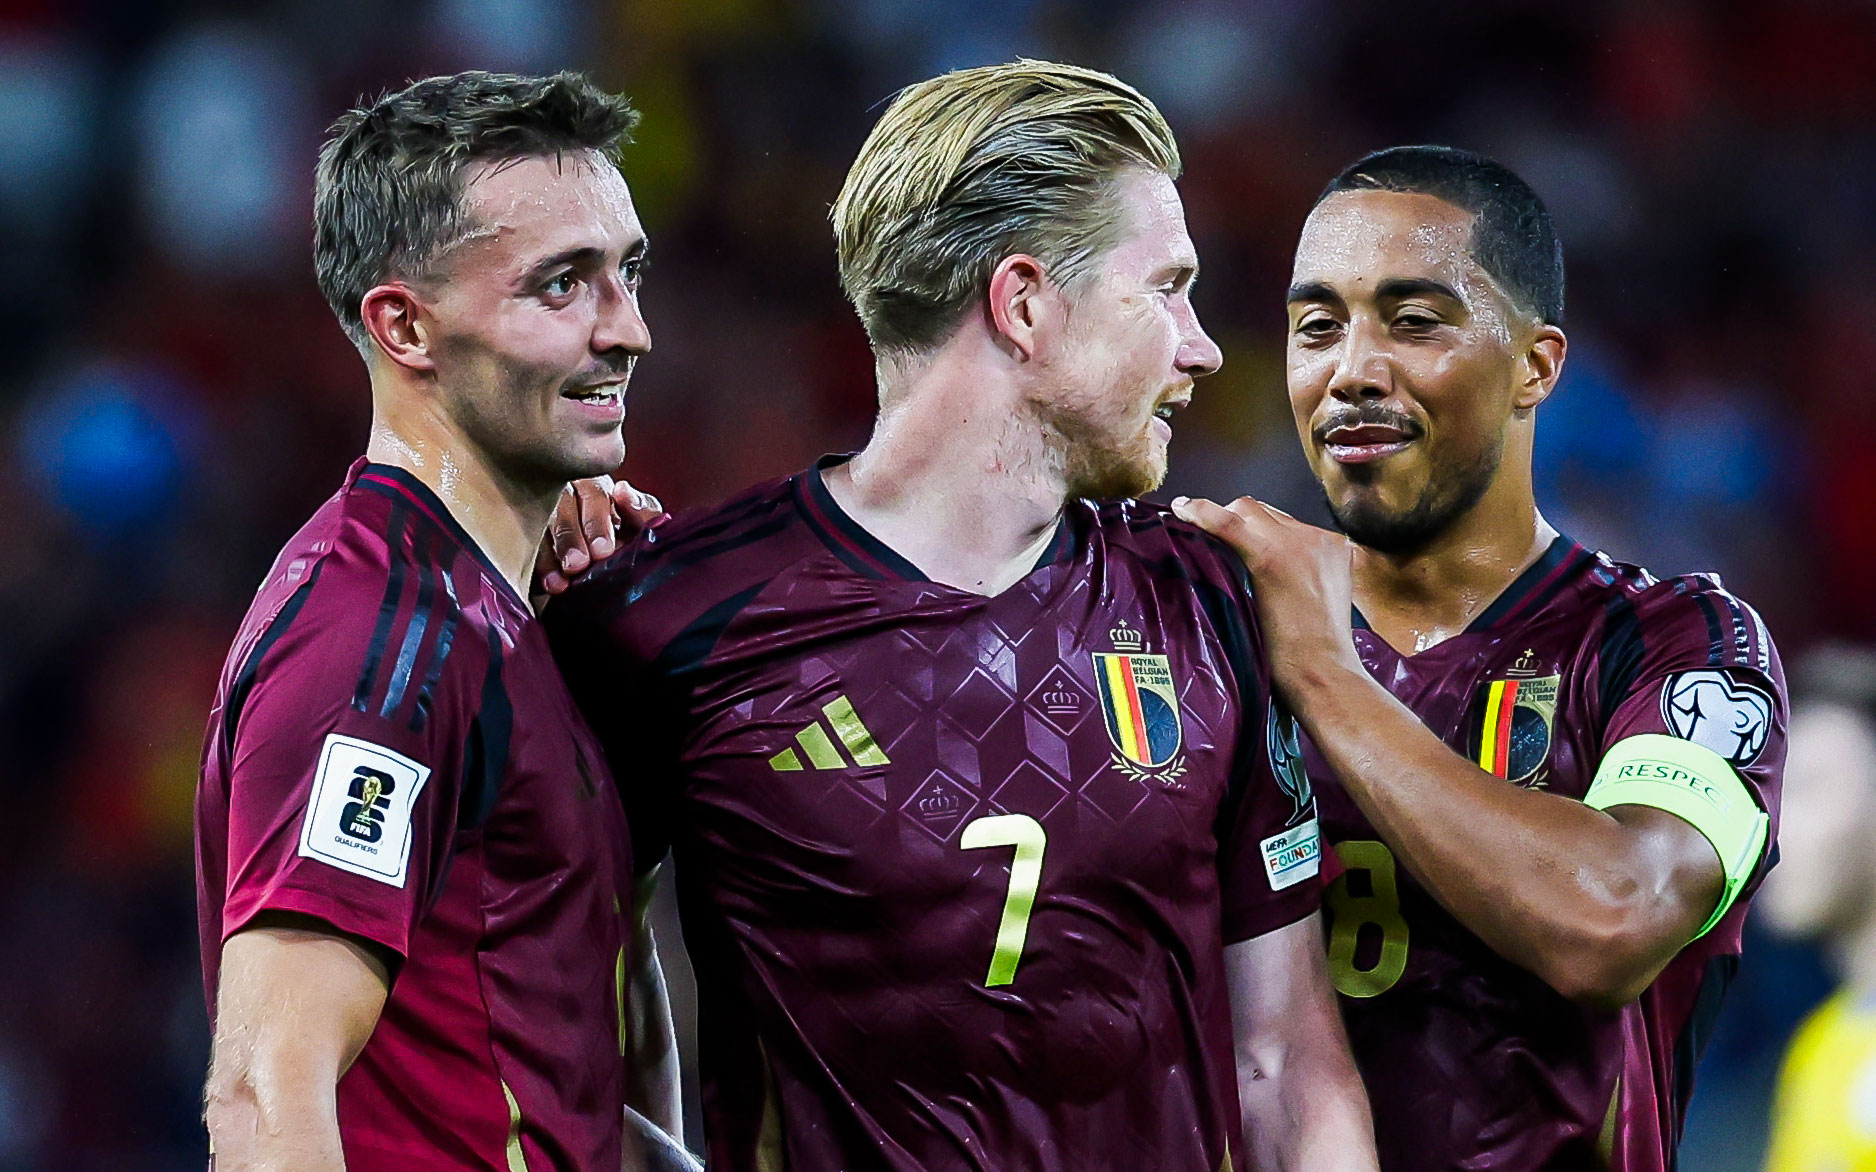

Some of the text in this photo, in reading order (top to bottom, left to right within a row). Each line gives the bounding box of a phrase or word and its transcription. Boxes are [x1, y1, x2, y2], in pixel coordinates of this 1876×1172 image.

[1618, 764, 1732, 812] RESPEC
[960, 813, 1047, 987] 7
[1325, 840, 1410, 998] 8
